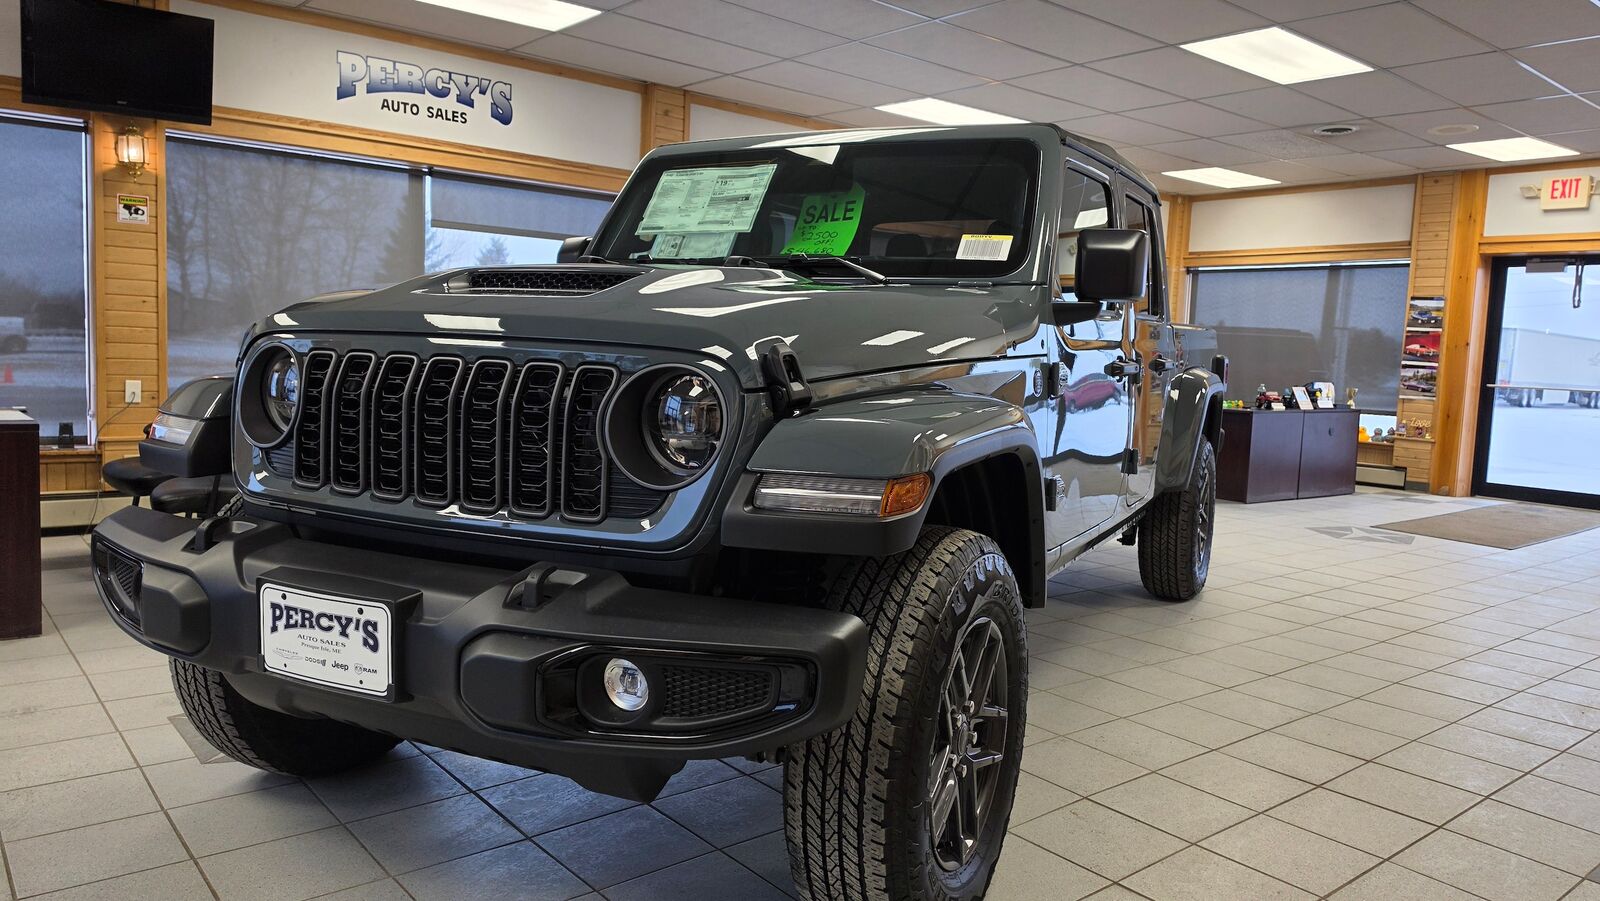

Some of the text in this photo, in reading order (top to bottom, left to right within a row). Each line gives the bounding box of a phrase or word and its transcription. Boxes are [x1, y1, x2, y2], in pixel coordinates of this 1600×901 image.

[337, 50, 513, 126] PERCY'S
[381, 98, 468, 124] AUTO SALES
[1550, 178, 1582, 199] EXIT
[803, 200, 856, 225] SALE
[270, 601, 380, 654] PERCY'S
[297, 633, 347, 648] AUTO SALES
[331, 661, 349, 672] Jeep
[362, 667, 378, 675] RAM
